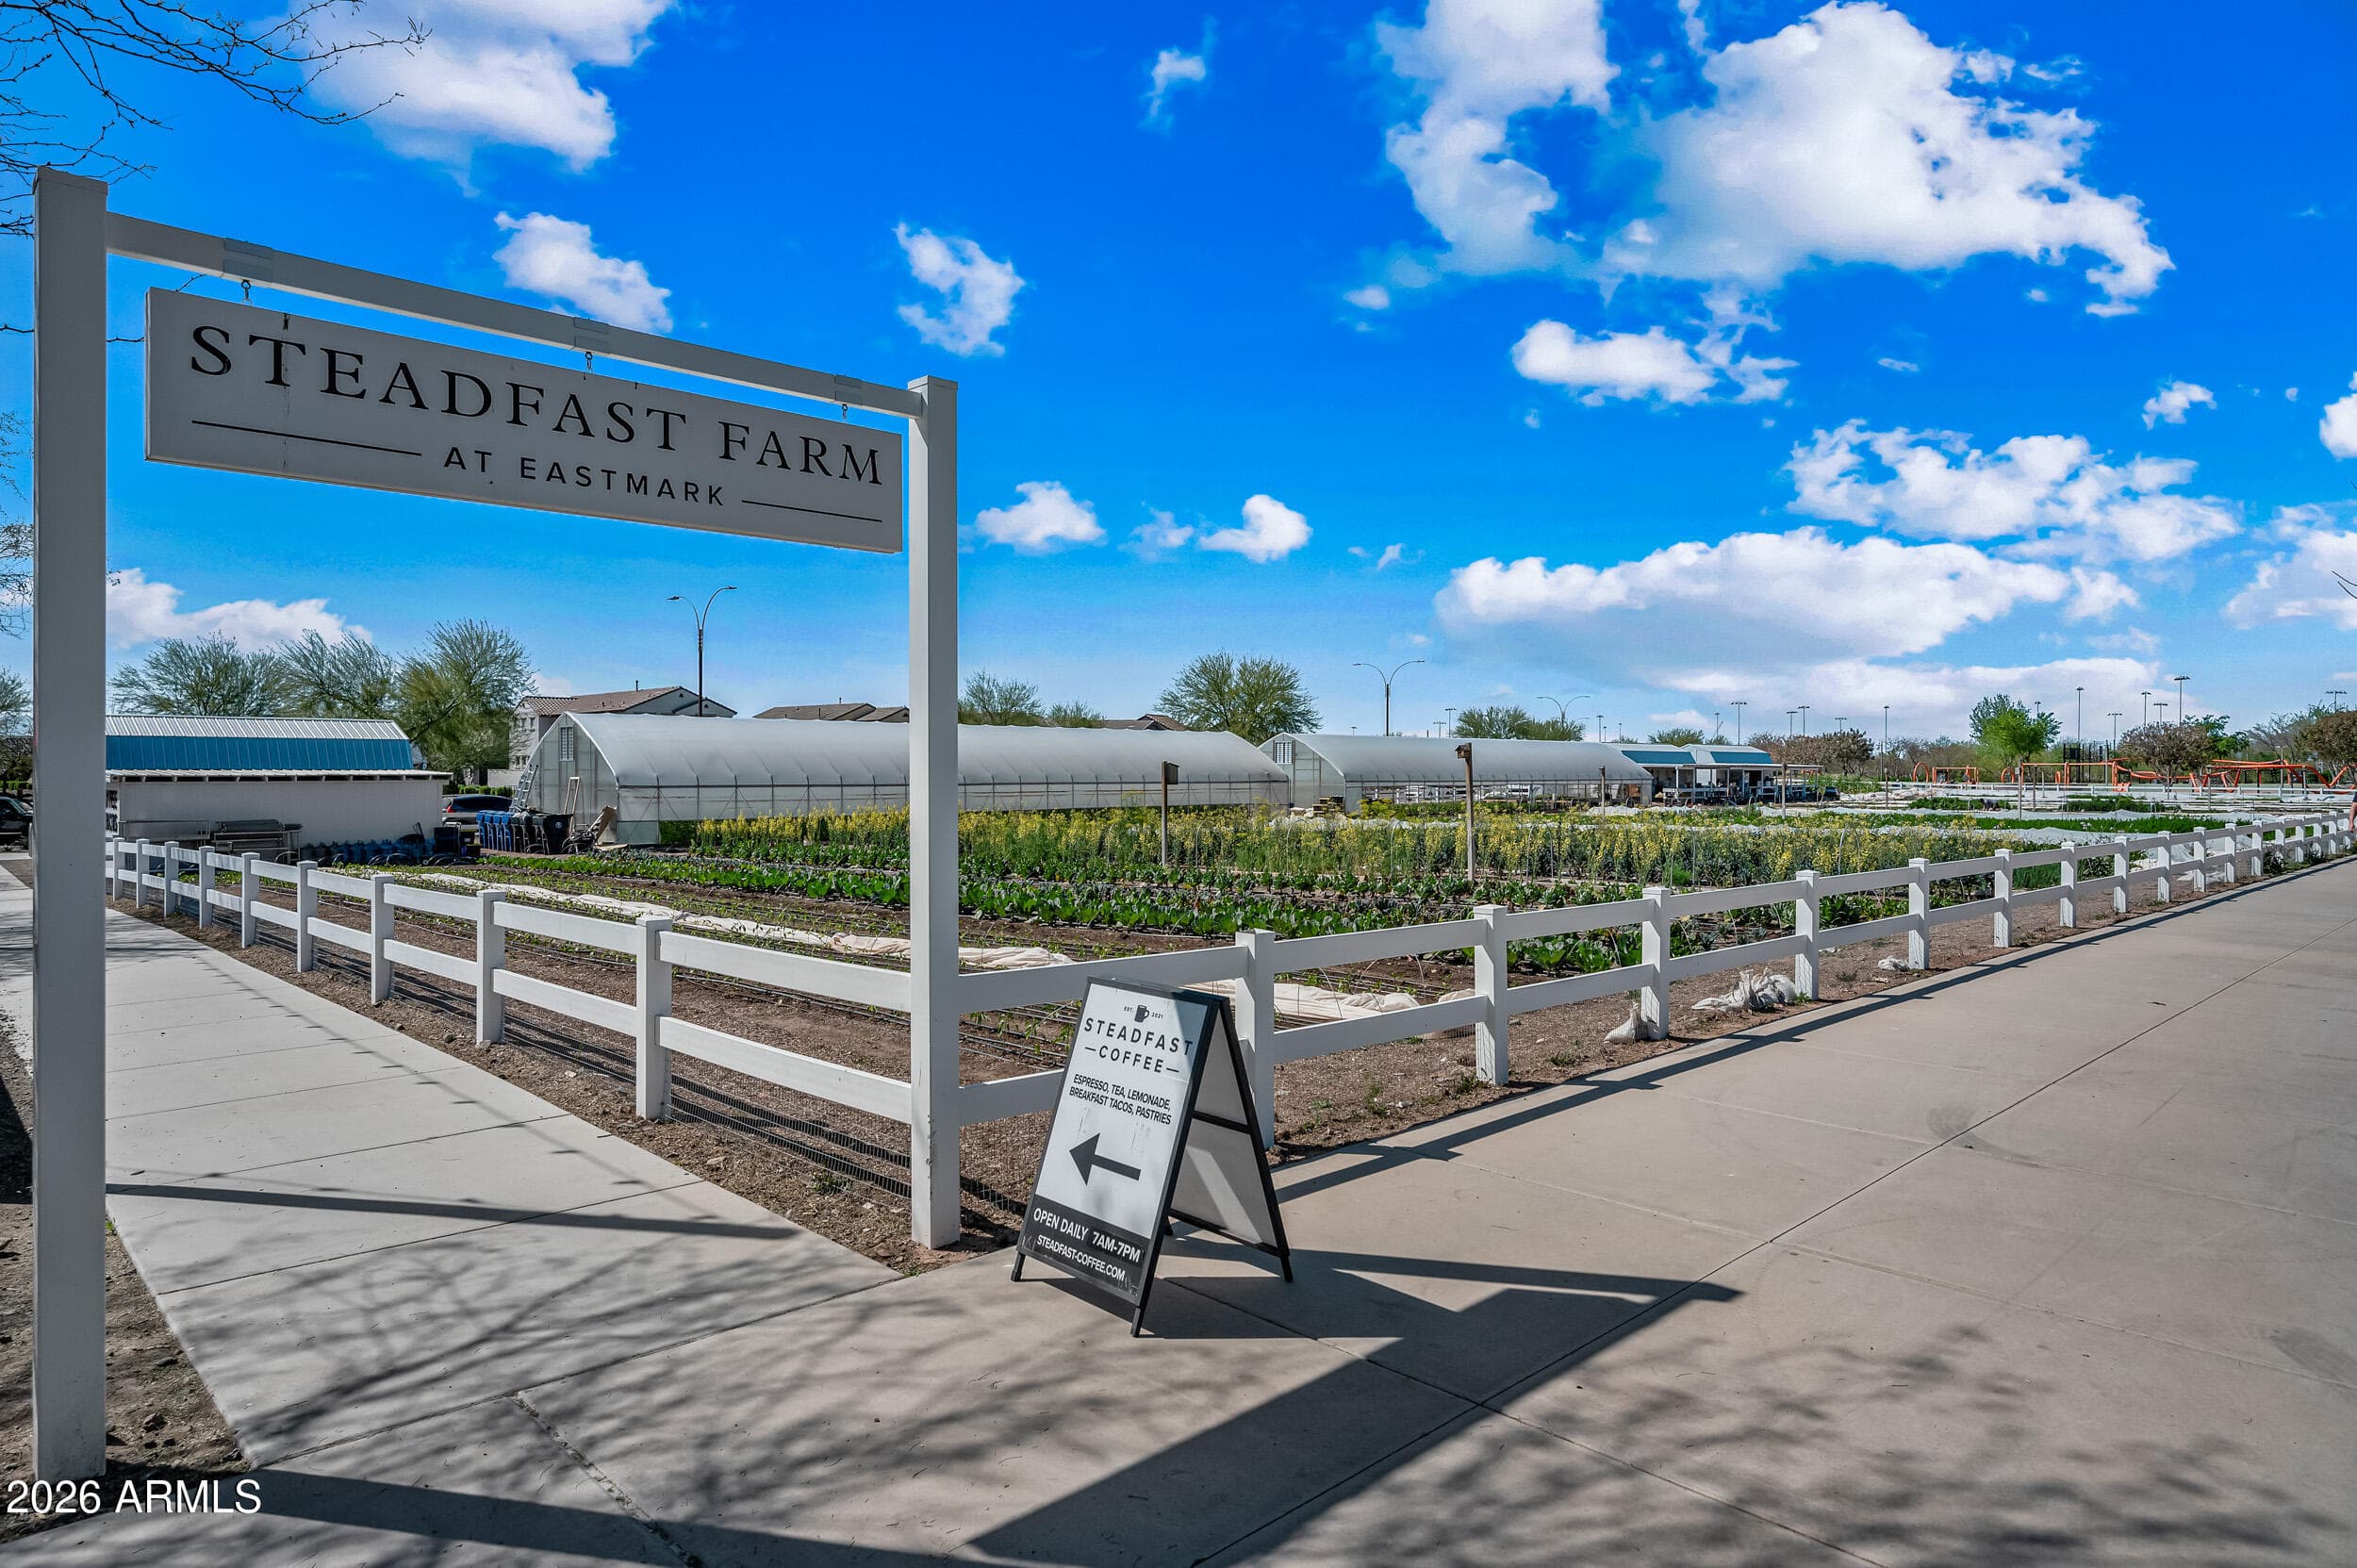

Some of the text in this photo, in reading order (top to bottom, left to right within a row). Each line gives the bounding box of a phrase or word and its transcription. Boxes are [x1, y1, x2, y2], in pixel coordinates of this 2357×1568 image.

[190, 324, 882, 485] STEADFAST FARM
[443, 446, 724, 505] AT EASTMARK
[1123, 1005, 1134, 1014] EST.
[1084, 1017, 1194, 1056] STEADFAST
[1098, 1045, 1164, 1074] COFFEE
[1069, 1085, 1172, 1125] BREAKFAST TACOS, PASTRIES
[1073, 1073, 1171, 1112] ESPRESSO, TEA, LEMONADE,
[1033, 1207, 1141, 1263] OPEN DAILY 7AM-7PM
[1036, 1233, 1126, 1281] STEADFAST-COFFEE.COM
